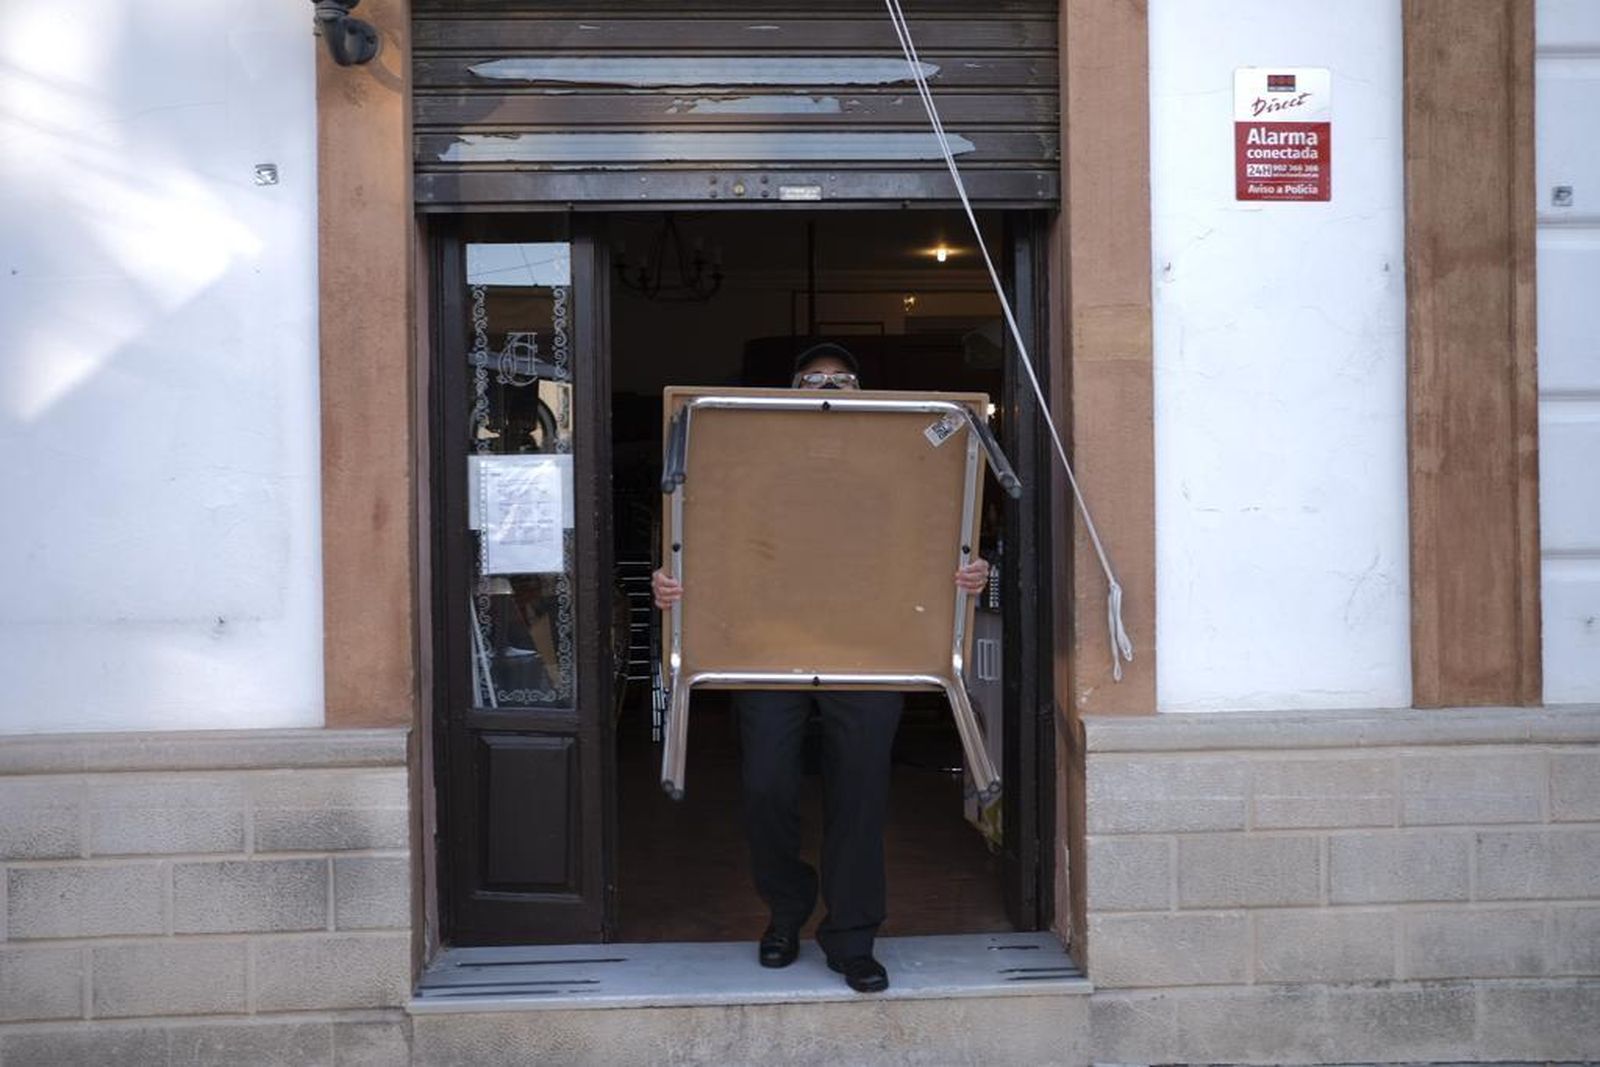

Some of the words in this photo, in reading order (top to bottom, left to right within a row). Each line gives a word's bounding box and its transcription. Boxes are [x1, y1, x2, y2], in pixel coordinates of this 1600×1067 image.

[1247, 128, 1318, 146] Alarma
[1247, 147, 1319, 159] conectada
[1248, 165, 1271, 176] 24H
[1248, 184, 1275, 194] Aviso
[1276, 186, 1283, 194] a
